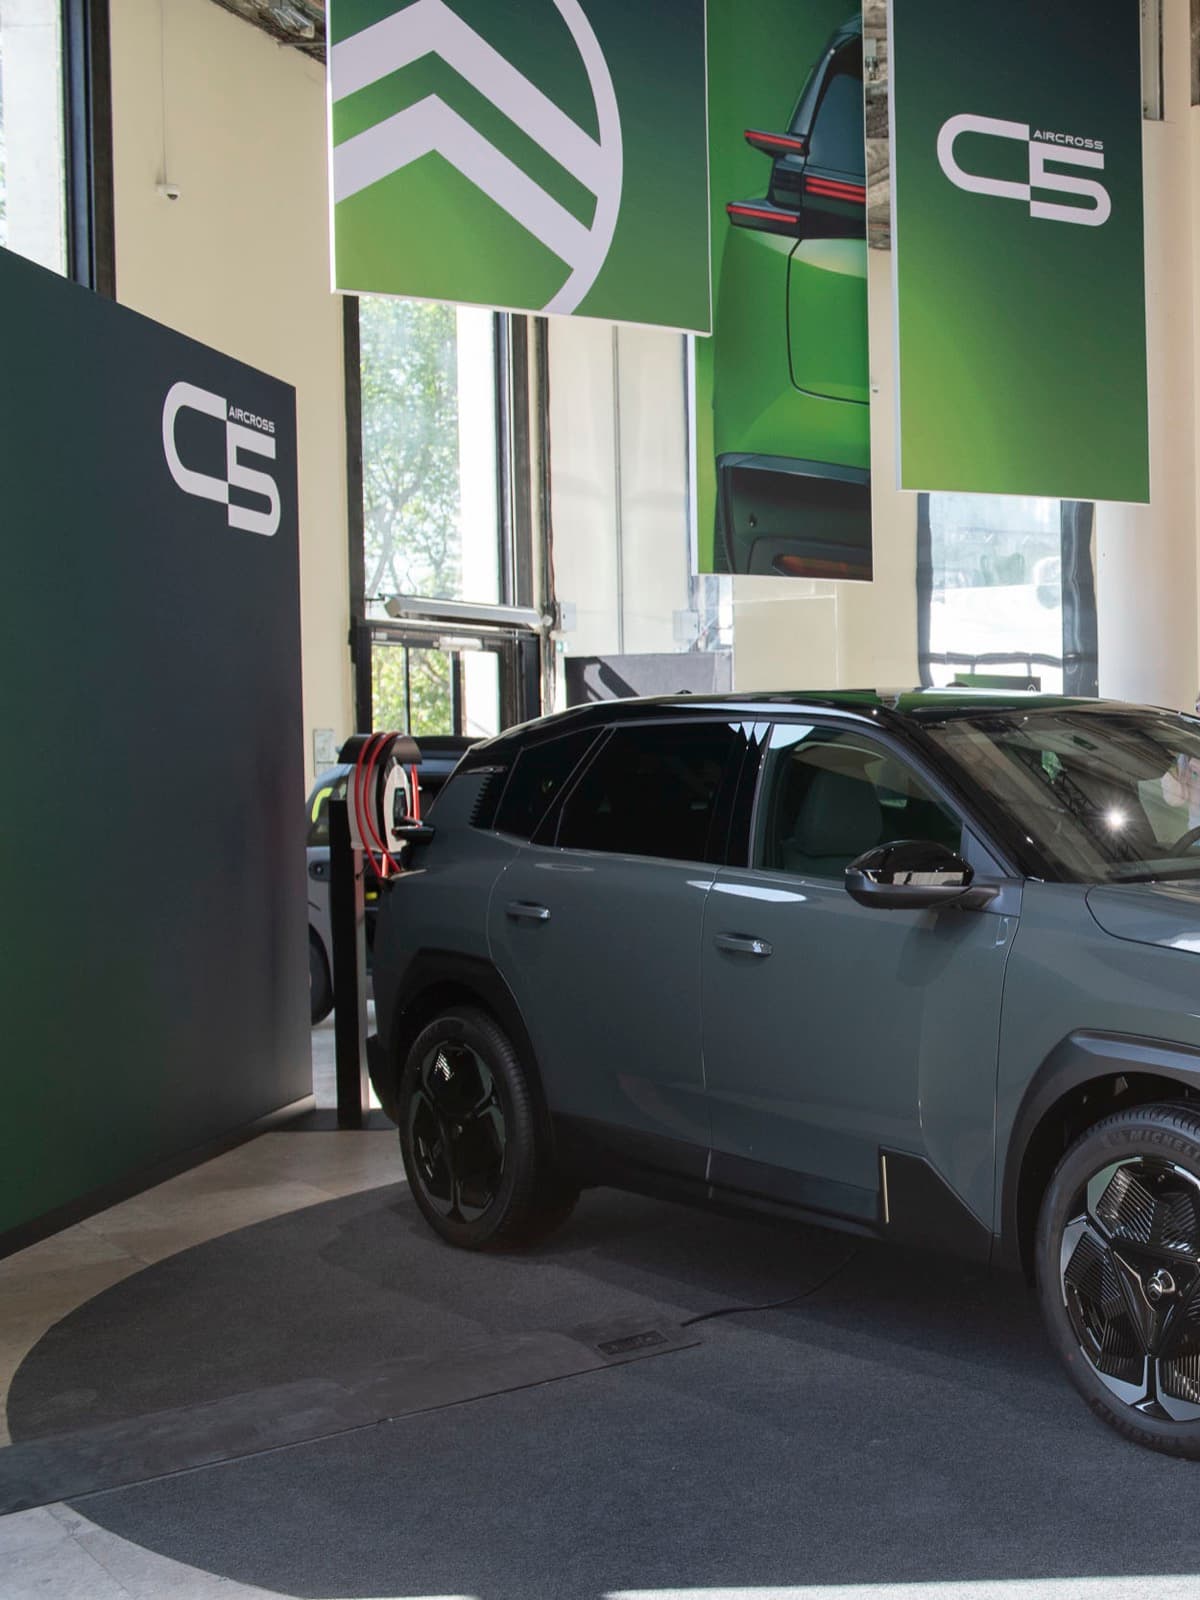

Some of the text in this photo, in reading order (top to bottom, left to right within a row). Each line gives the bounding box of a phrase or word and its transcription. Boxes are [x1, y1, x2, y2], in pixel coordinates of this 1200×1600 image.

[937, 113, 1111, 227] C5
[1032, 130, 1104, 150] AIRCROSS
[228, 405, 276, 434] AIRCROSS
[162, 381, 281, 537] C5
